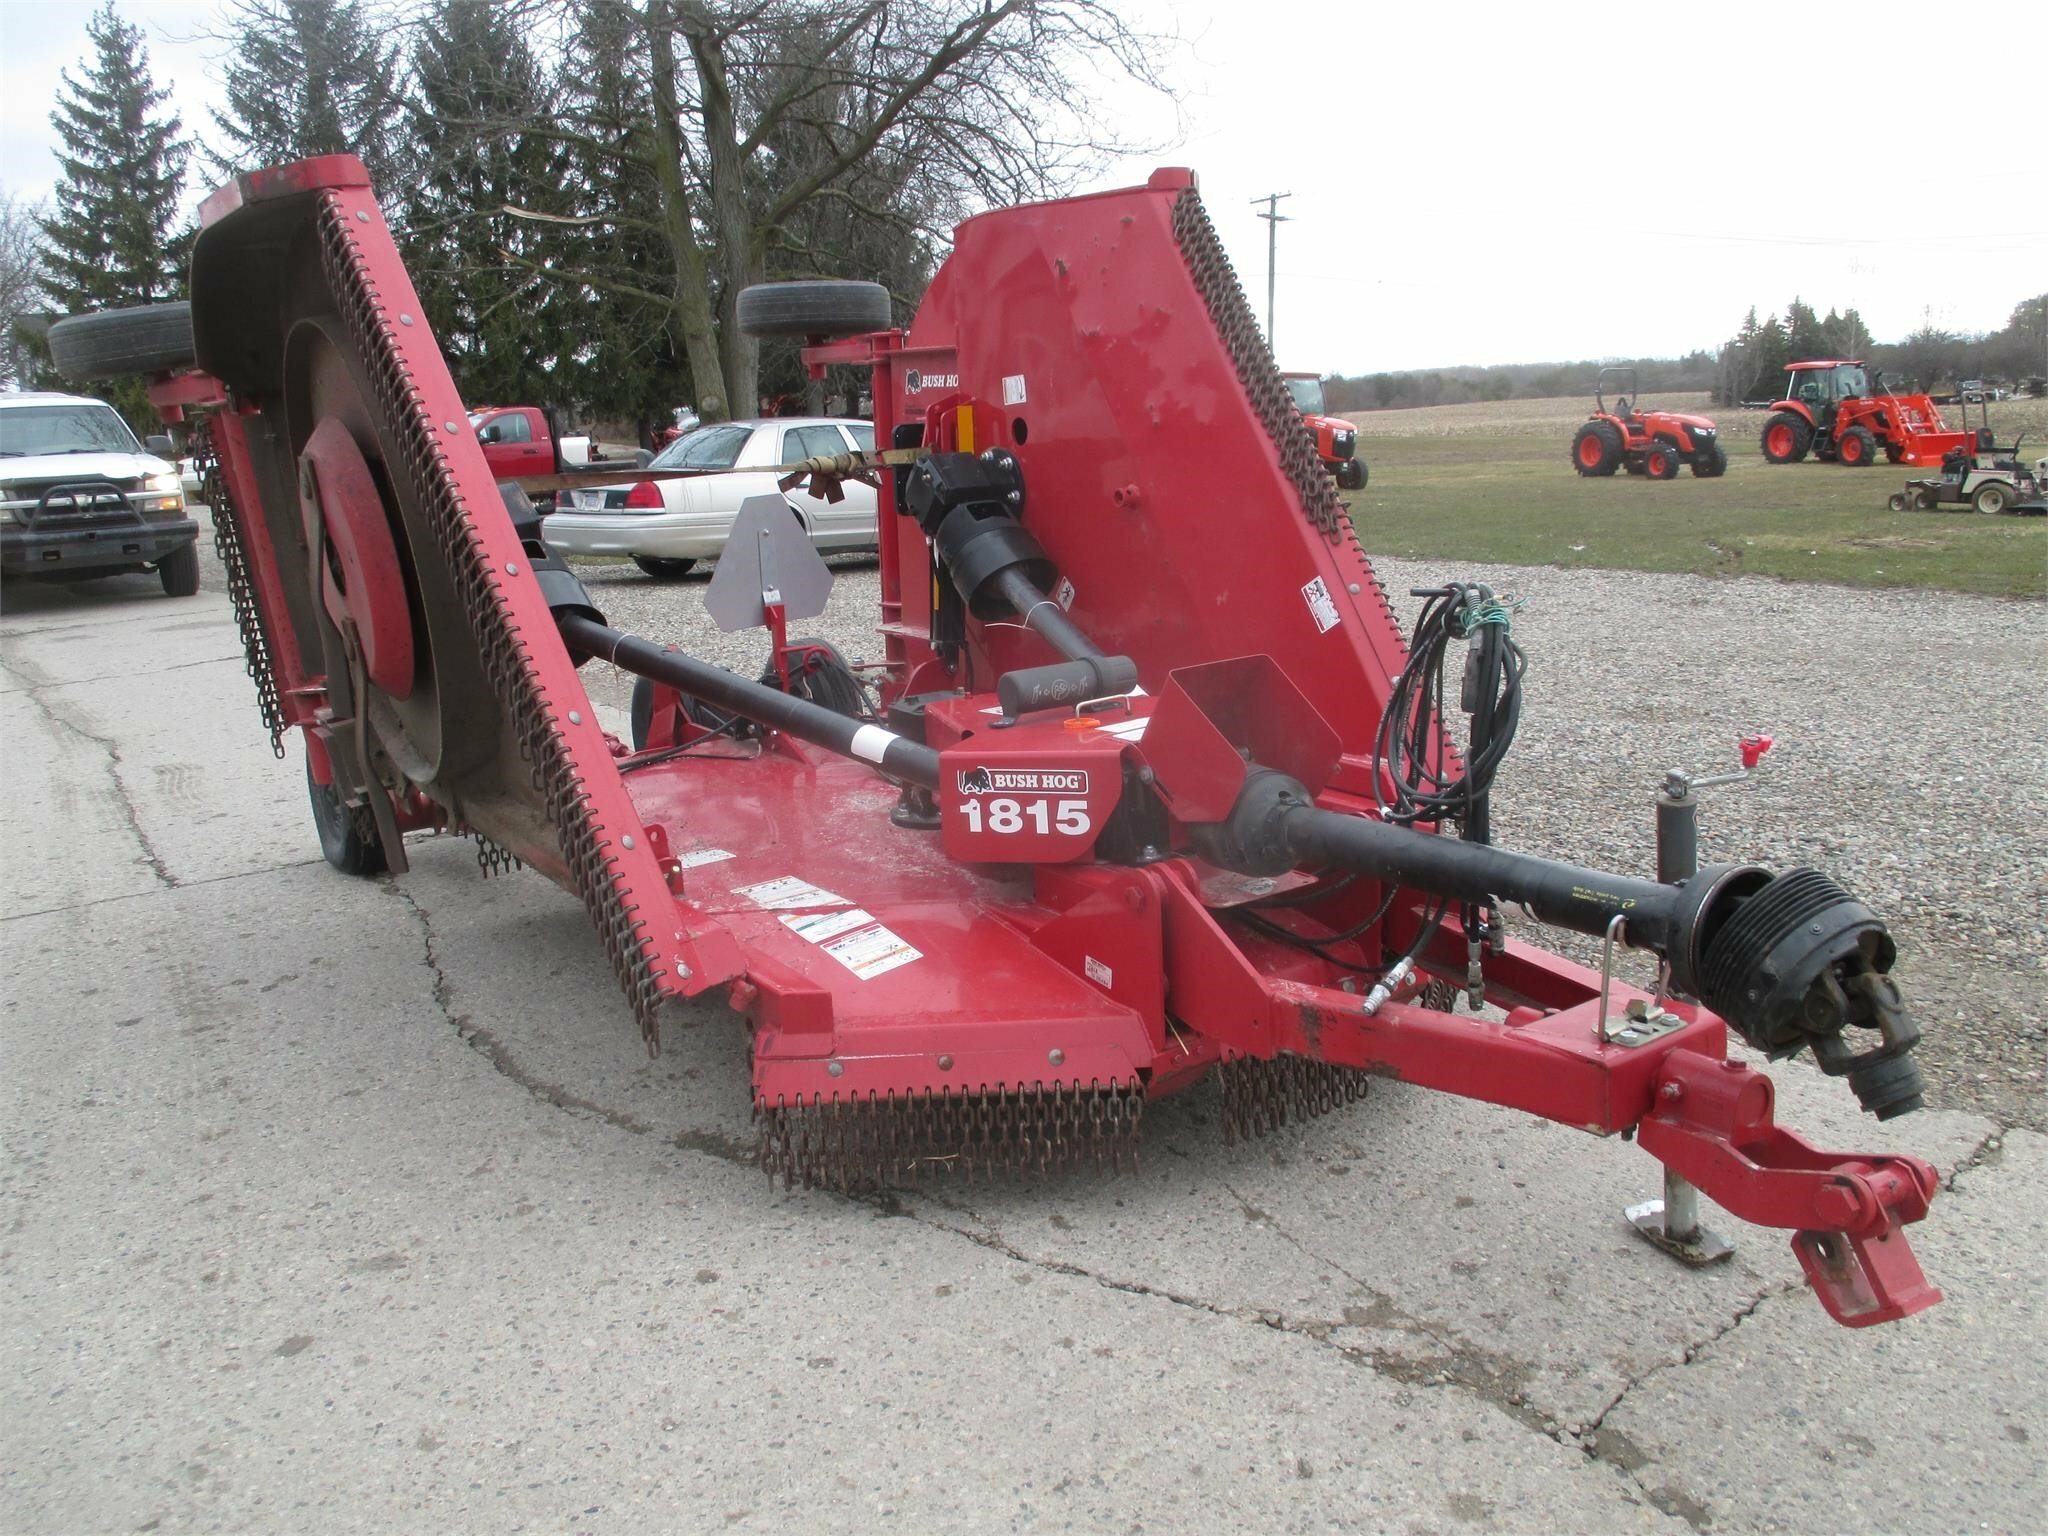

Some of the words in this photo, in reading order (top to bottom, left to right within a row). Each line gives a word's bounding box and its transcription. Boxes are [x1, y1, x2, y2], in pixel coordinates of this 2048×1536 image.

[922, 374, 945, 388] BUSH
[946, 374, 959, 388] HO
[995, 774, 1038, 788] BUSH
[1042, 775, 1080, 789] HOG
[959, 799, 1090, 835] 1815
